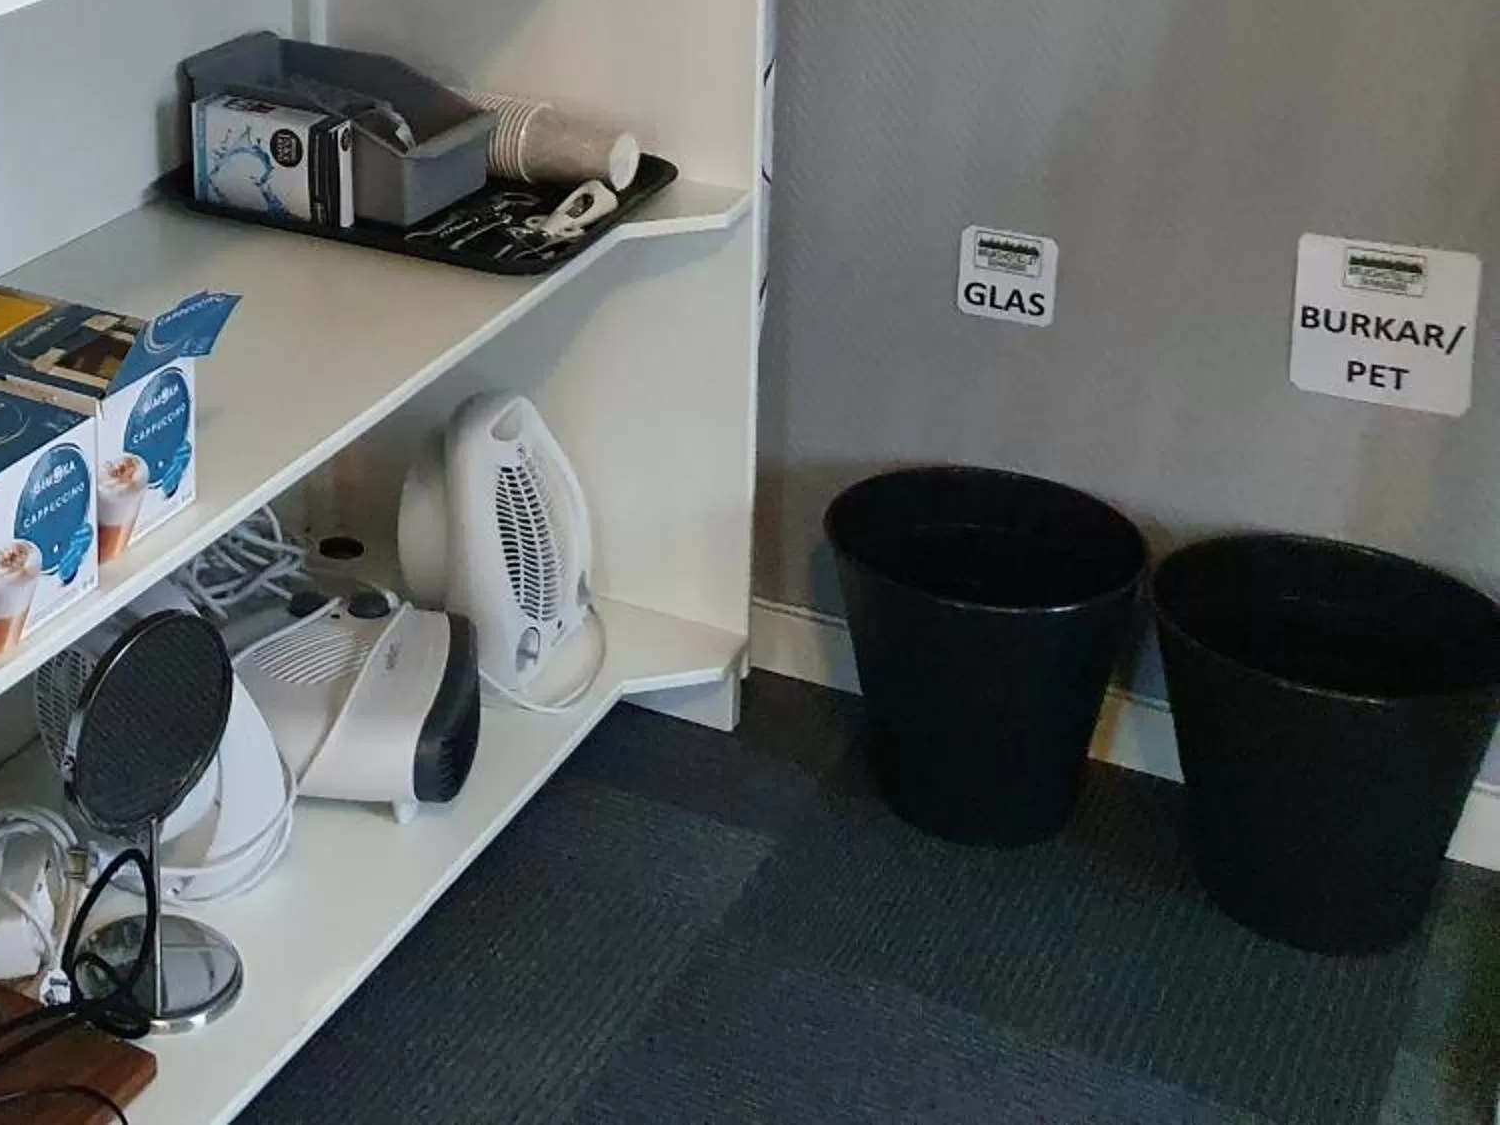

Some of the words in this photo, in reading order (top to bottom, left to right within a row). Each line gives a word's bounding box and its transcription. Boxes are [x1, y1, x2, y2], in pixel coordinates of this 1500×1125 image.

[964, 282, 1045, 316] GLAS
[1301, 304, 1467, 355] BURKAR/
[1347, 360, 1410, 390] PET
[133, 402, 186, 444] CAPPUCCINO
[23, 481, 85, 528] CAPPUCCINO
